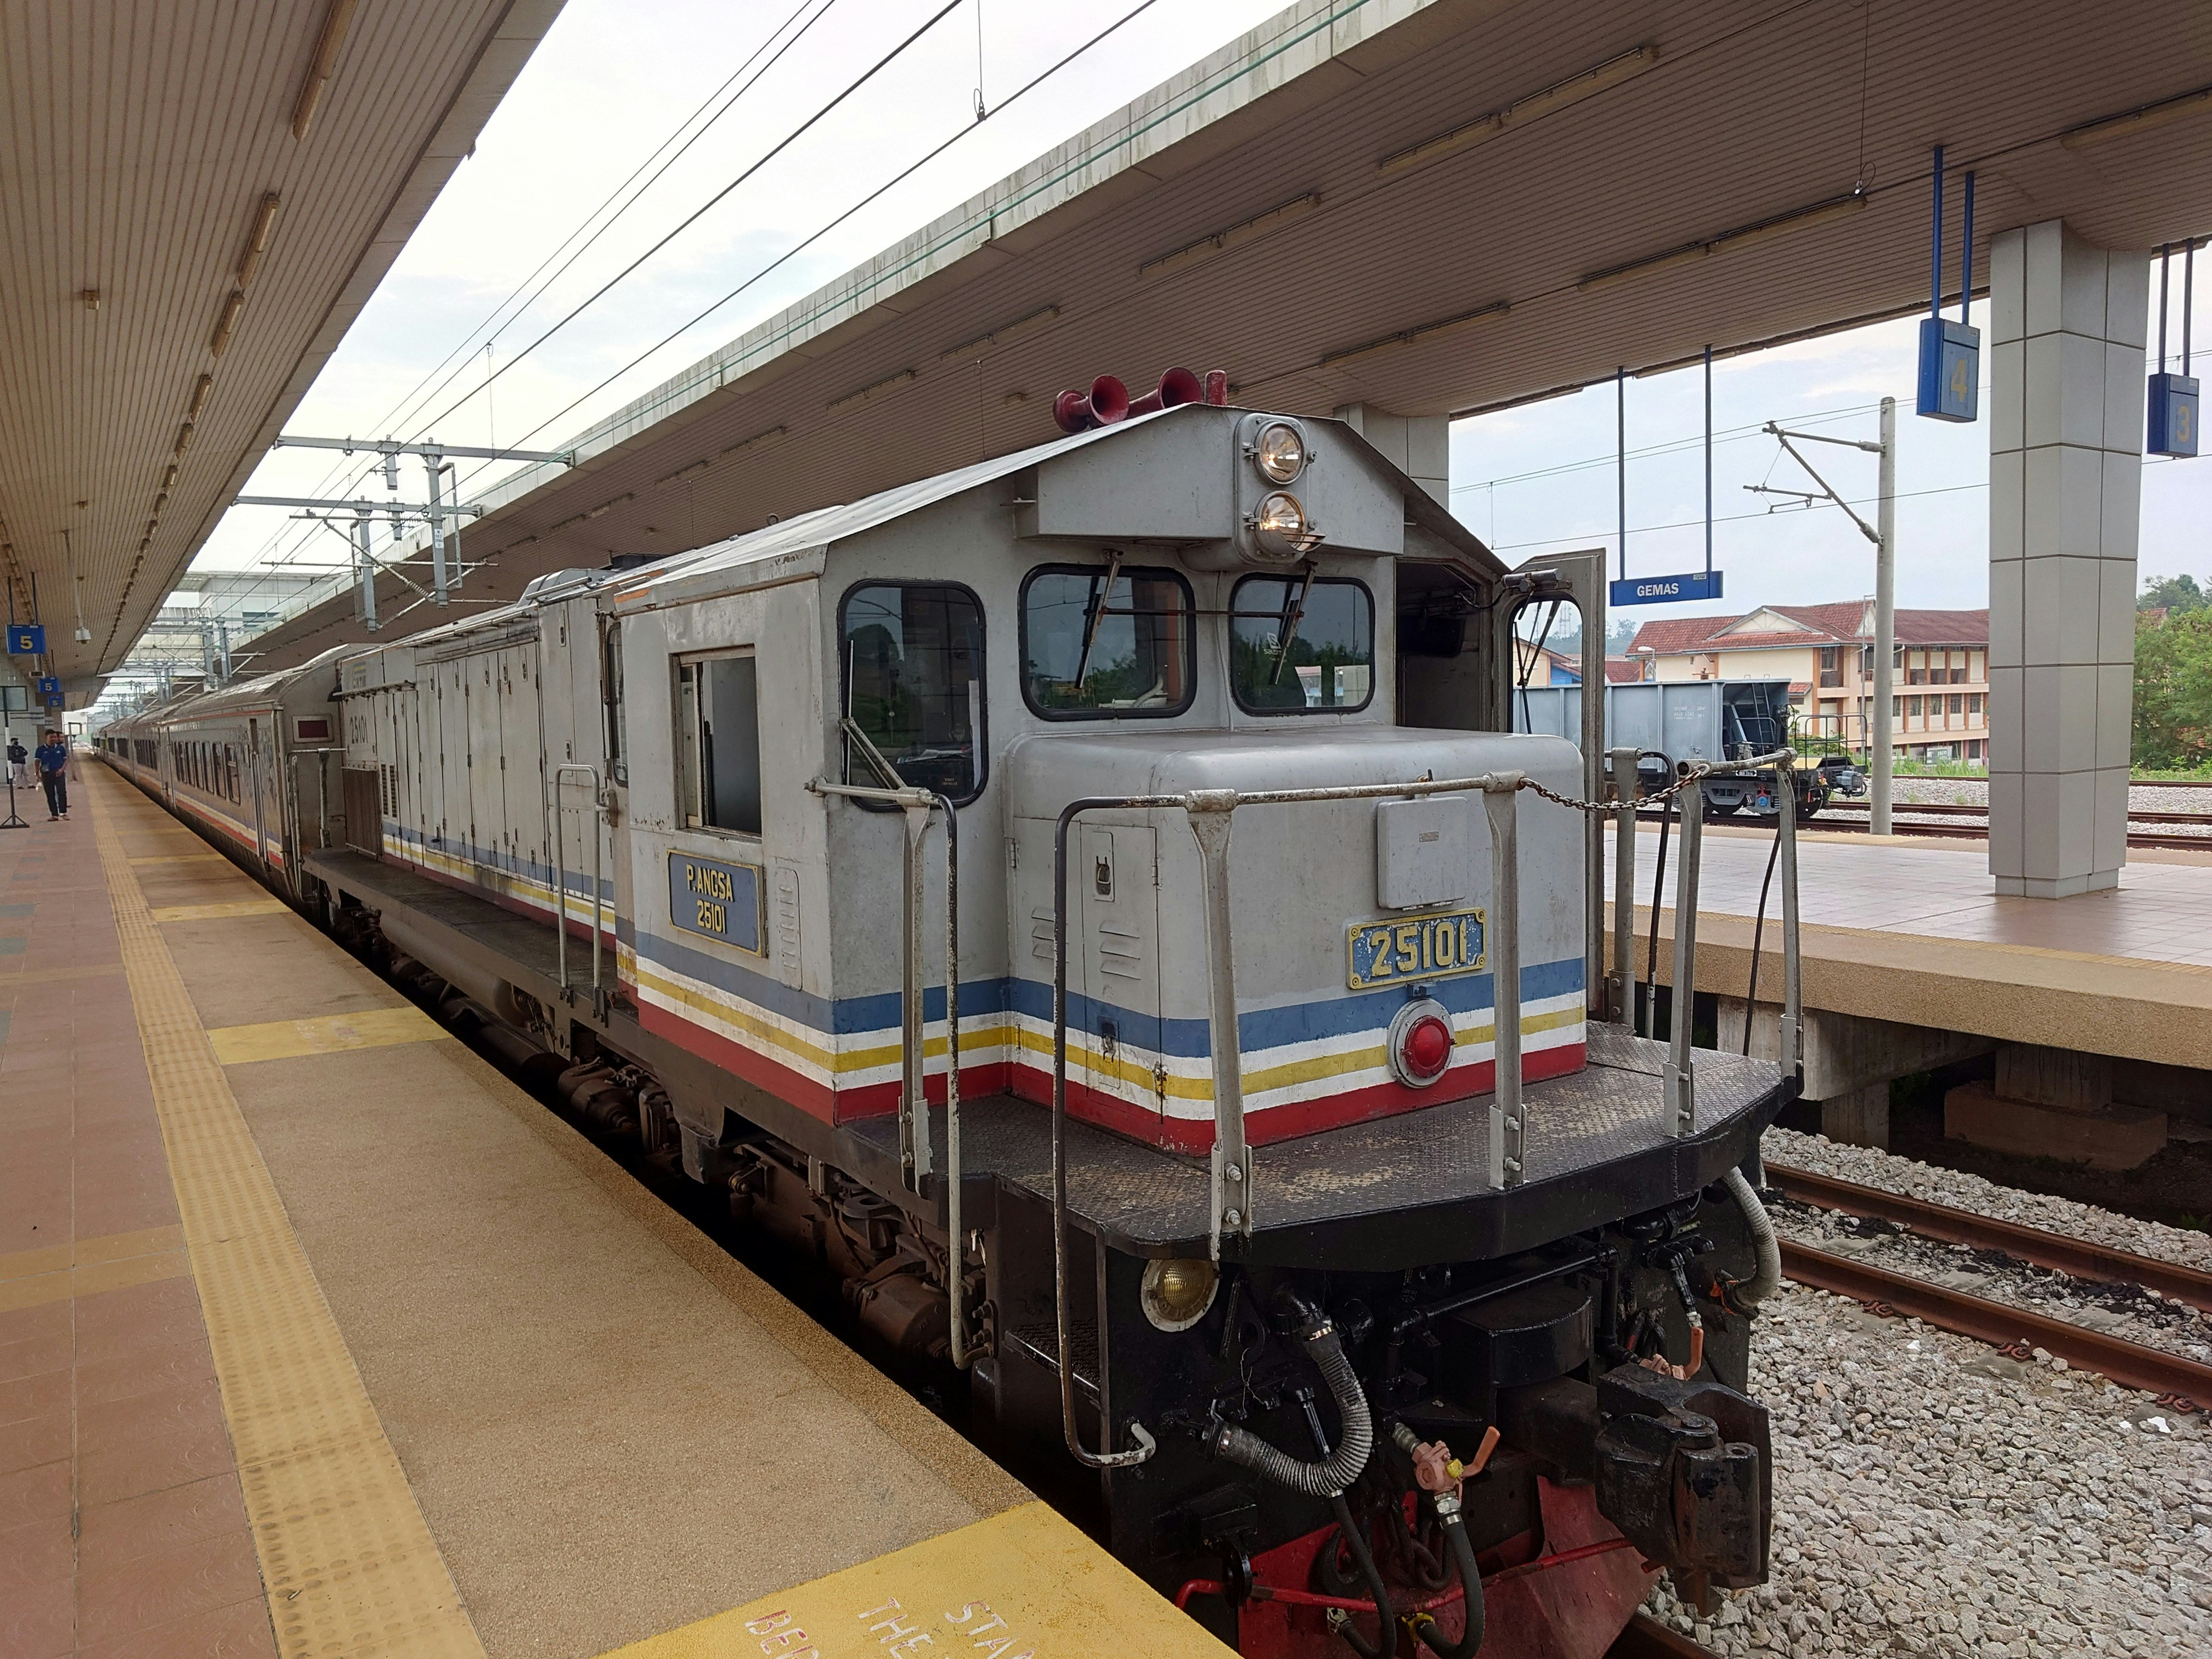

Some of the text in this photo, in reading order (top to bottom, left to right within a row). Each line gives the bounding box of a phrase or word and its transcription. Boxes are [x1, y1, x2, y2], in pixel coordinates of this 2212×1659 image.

[1950, 359, 1967, 402] 4
[2177, 405, 2191, 442] 3
[1637, 583, 1679, 597] GEMAS
[20, 635, 33, 650] 5
[45, 682, 53, 691] 5
[350, 714, 369, 744] 25101
[686, 864, 733, 902] P.ANGSA
[697, 899, 726, 934] 25101
[1371, 917, 1467, 977] 25101
[858, 1597, 935, 1659] THE
